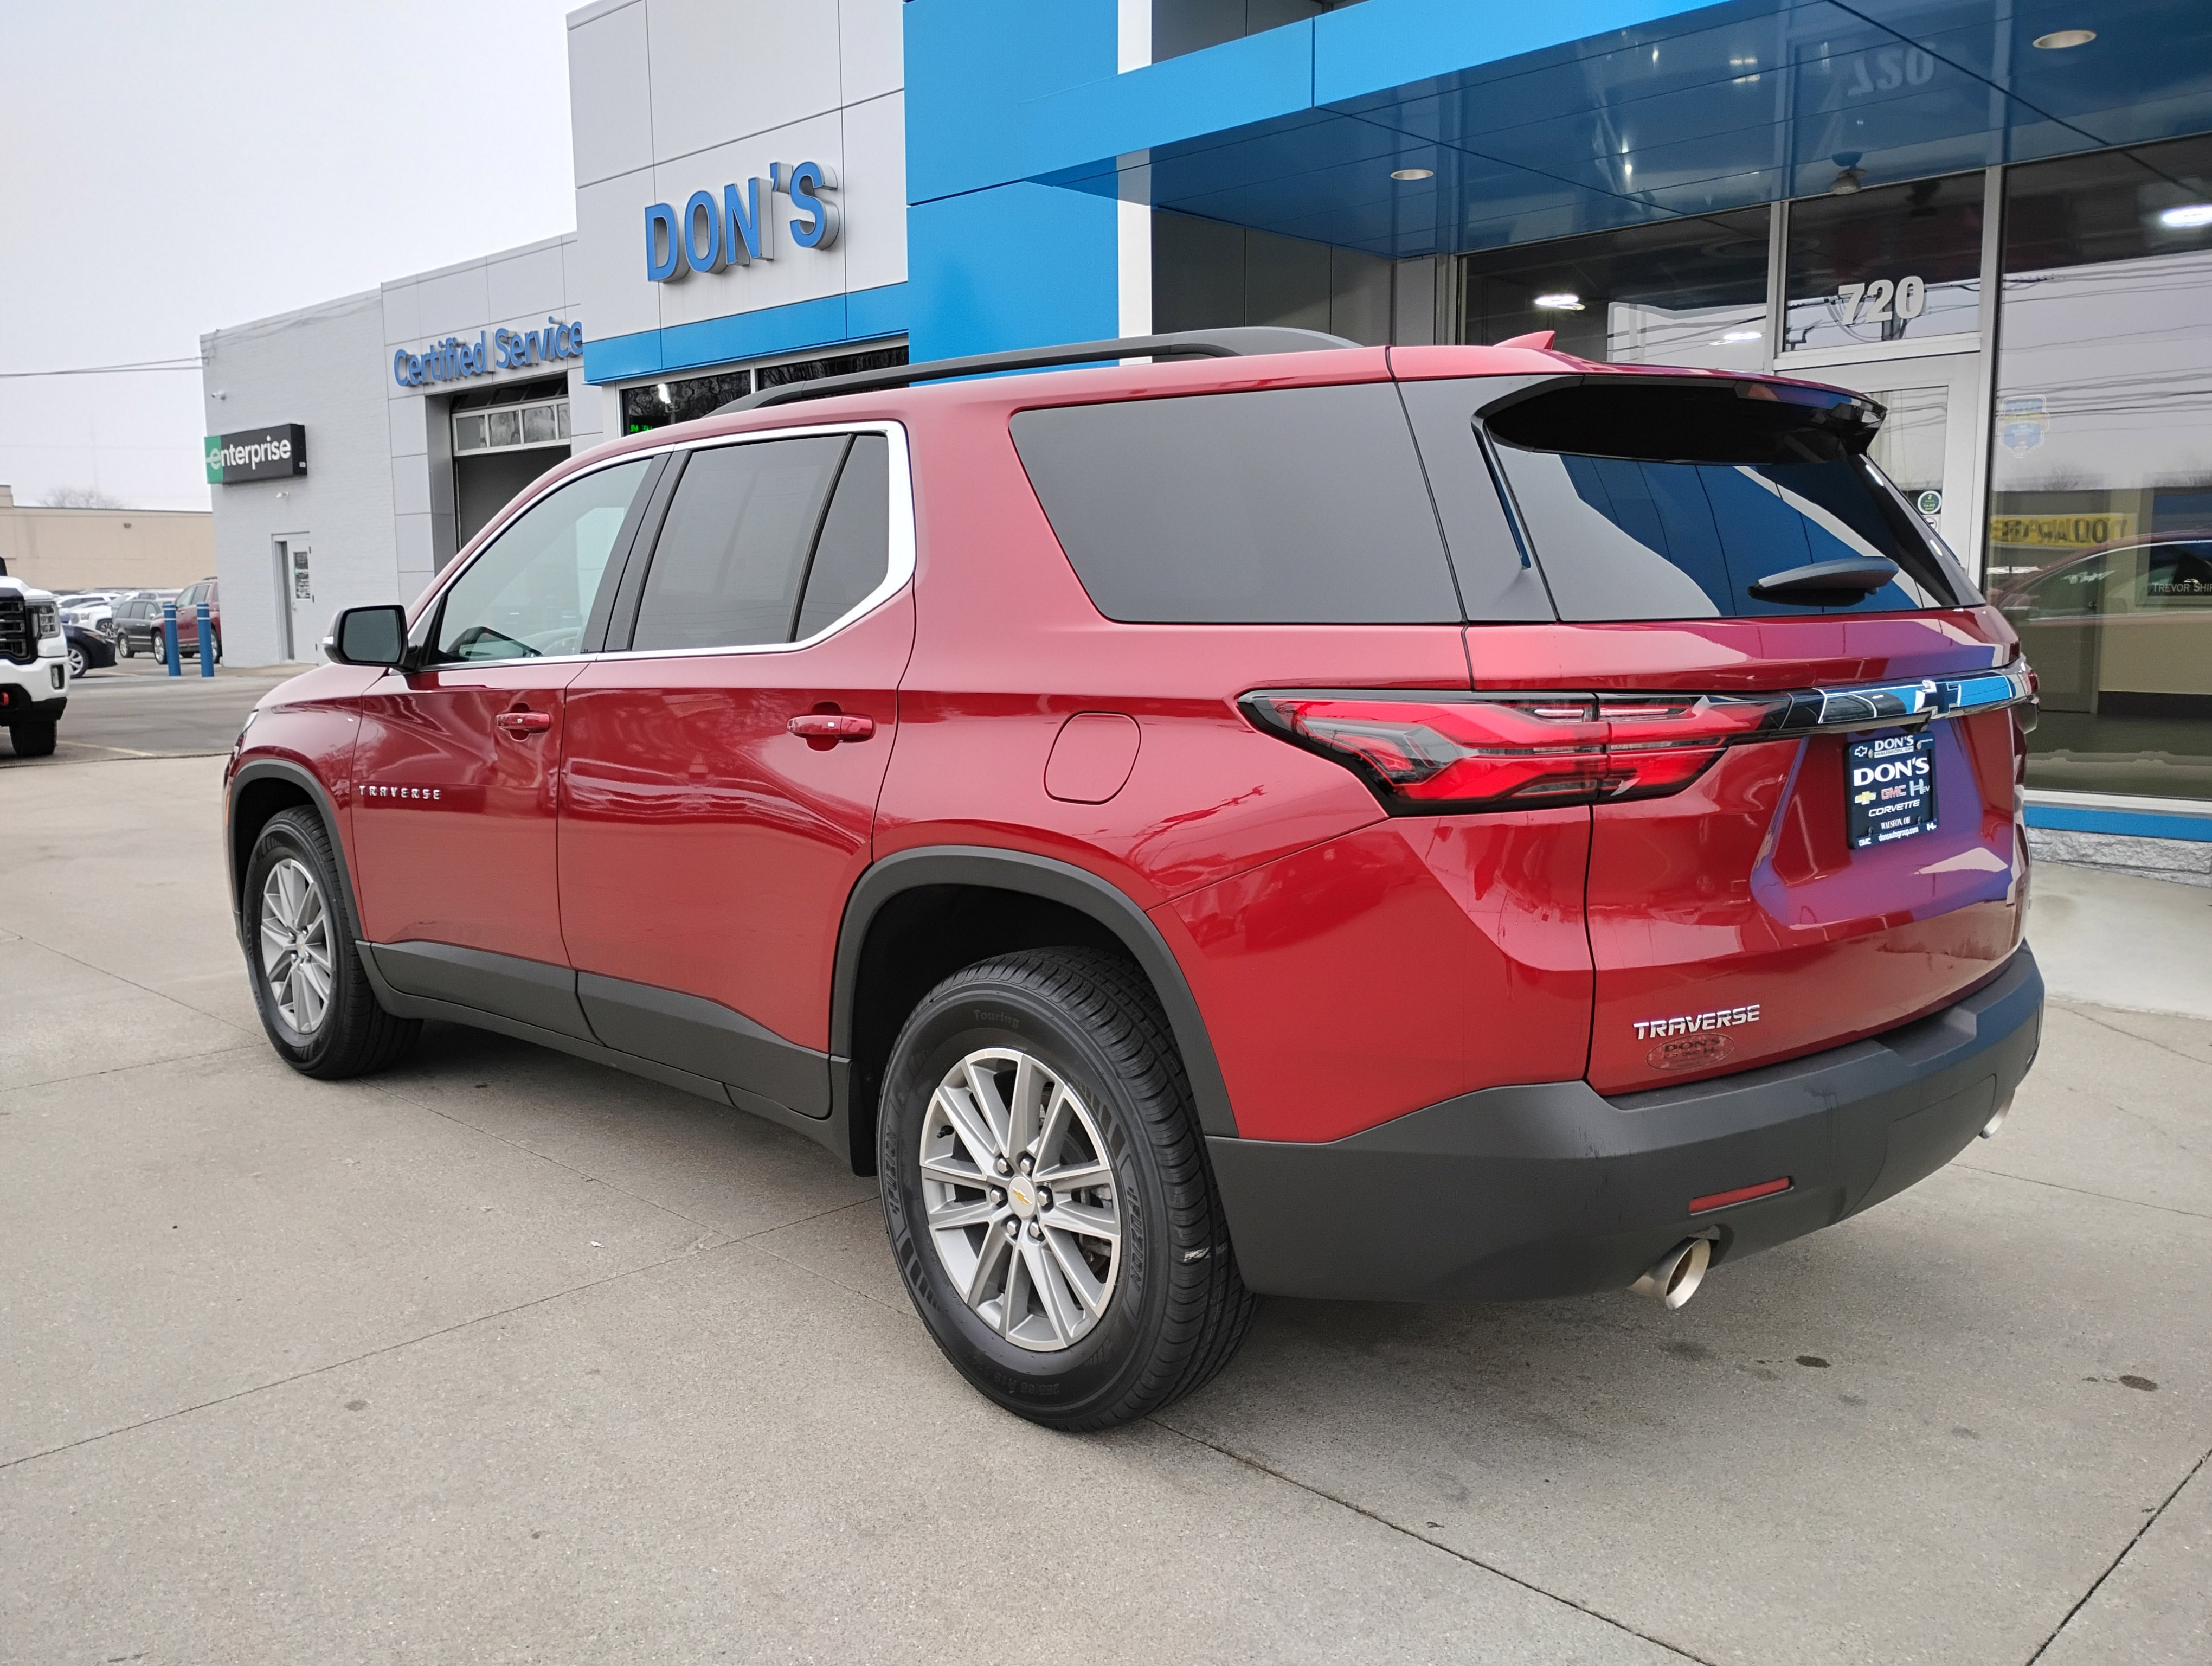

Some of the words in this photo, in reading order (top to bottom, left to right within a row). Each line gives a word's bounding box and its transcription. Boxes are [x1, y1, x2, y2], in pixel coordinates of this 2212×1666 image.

[645, 161, 833, 282] DON'S
[1838, 275, 1925, 325] 720
[394, 330, 490, 387] Certified
[494, 315, 583, 369] Service
[206, 435, 292, 470] enterprise
[2152, 582, 2190, 592] TREVOR
[1874, 735, 1914, 752] DON'S
[1853, 757, 1930, 787] DON'S
[359, 785, 441, 800] TRAVERSE
[1881, 784, 1907, 800] GMC
[1868, 799, 1920, 817] CORVETTE
[1858, 837, 1872, 847] GMC
[973, 1009, 1020, 1029] Touring
[1633, 1004, 1760, 1040] TRAVERSE
[884, 1124, 898, 1204] FUZION
[1127, 1199, 1144, 1292] FUZION
